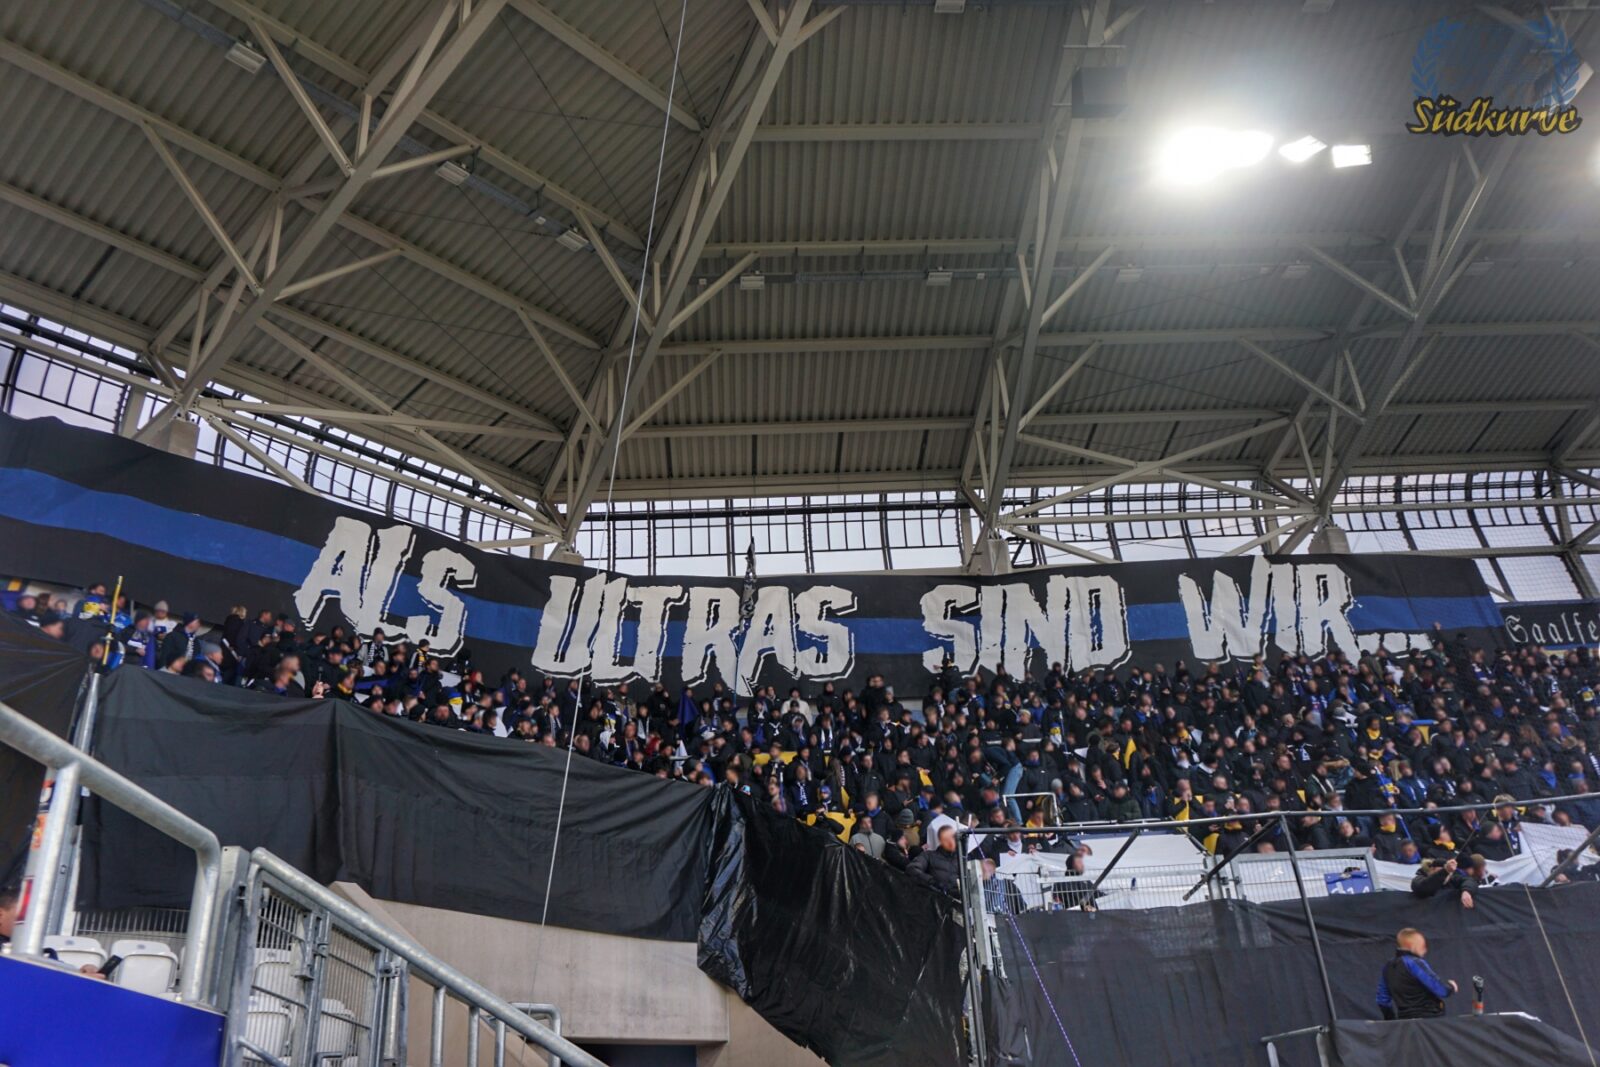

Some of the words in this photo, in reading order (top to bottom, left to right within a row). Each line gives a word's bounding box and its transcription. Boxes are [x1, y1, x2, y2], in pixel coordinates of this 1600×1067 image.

[293, 516, 478, 658] ALS
[531, 573, 857, 697] ULTRAS
[920, 574, 1132, 683] SIND
[1505, 612, 1600, 645] Saalfe
